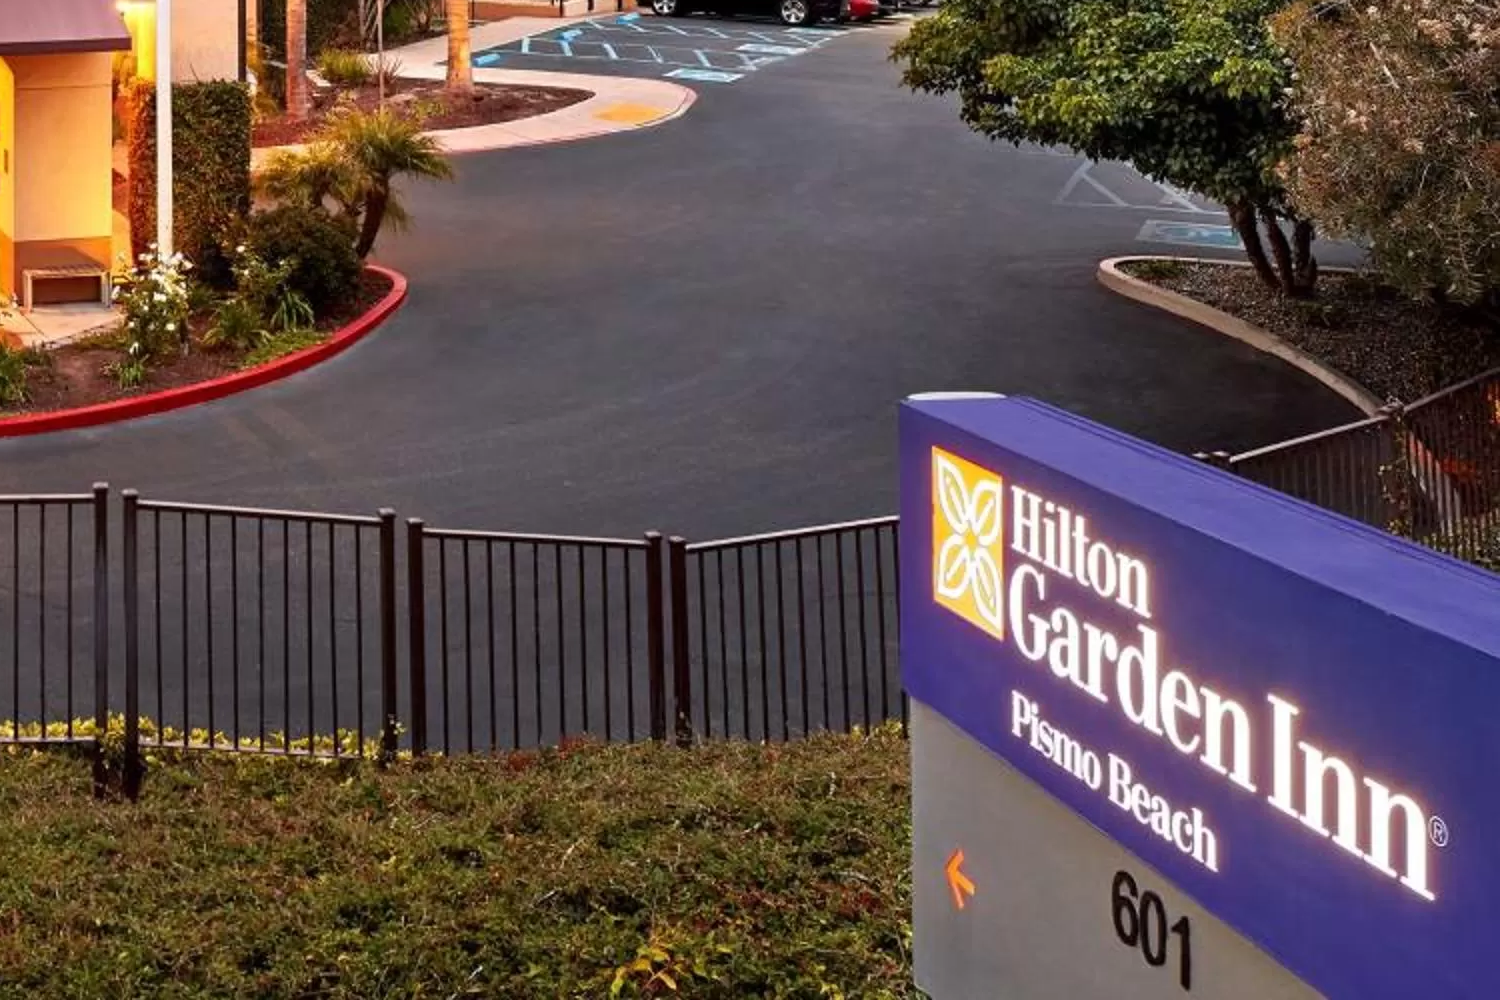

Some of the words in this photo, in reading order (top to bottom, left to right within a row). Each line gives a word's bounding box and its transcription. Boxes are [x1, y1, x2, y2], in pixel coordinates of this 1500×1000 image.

[1011, 485, 1151, 618] Hilton
[1008, 563, 1257, 793] Garden
[1011, 689, 1101, 790] Pismo
[1107, 752, 1219, 873] Beach
[1111, 870, 1192, 991] 601
